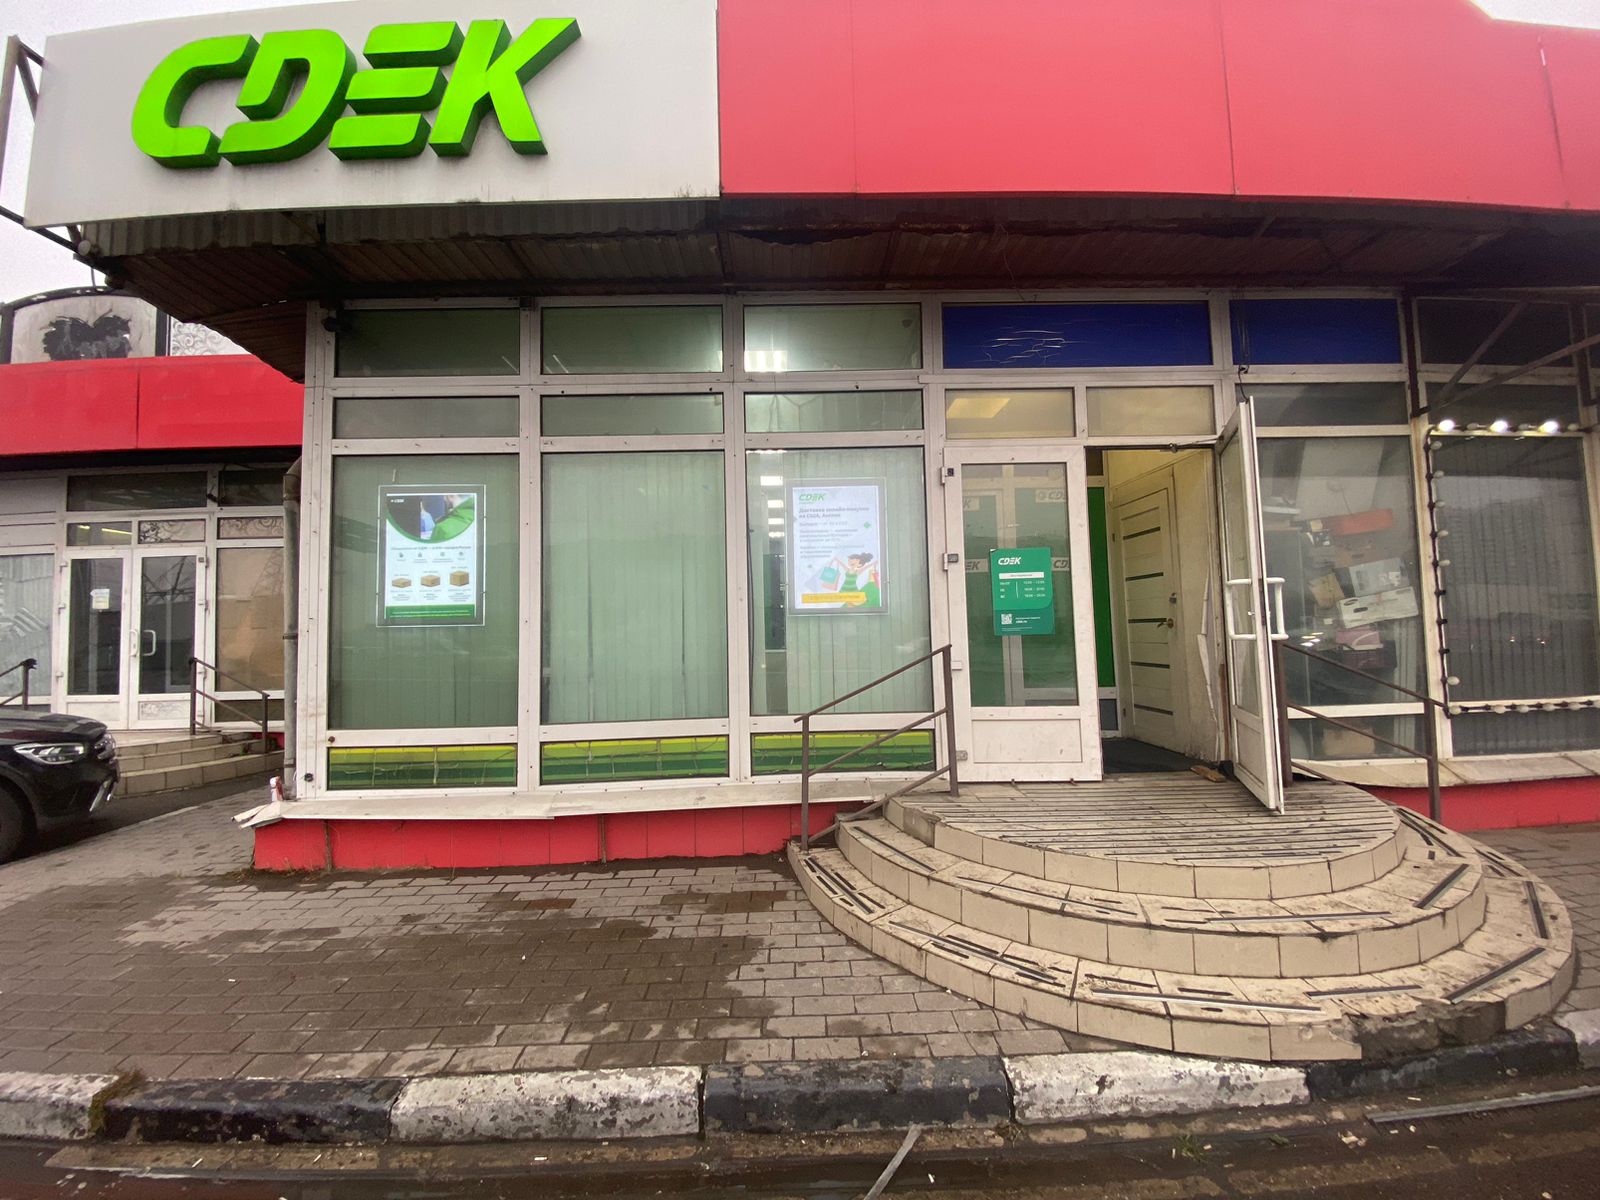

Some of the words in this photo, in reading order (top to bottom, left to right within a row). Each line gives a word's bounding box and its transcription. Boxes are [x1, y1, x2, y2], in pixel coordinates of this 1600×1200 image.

[131, 17, 581, 168] CDEK
[799, 493, 825, 501] CDEK
[998, 556, 1022, 566] CDEK
